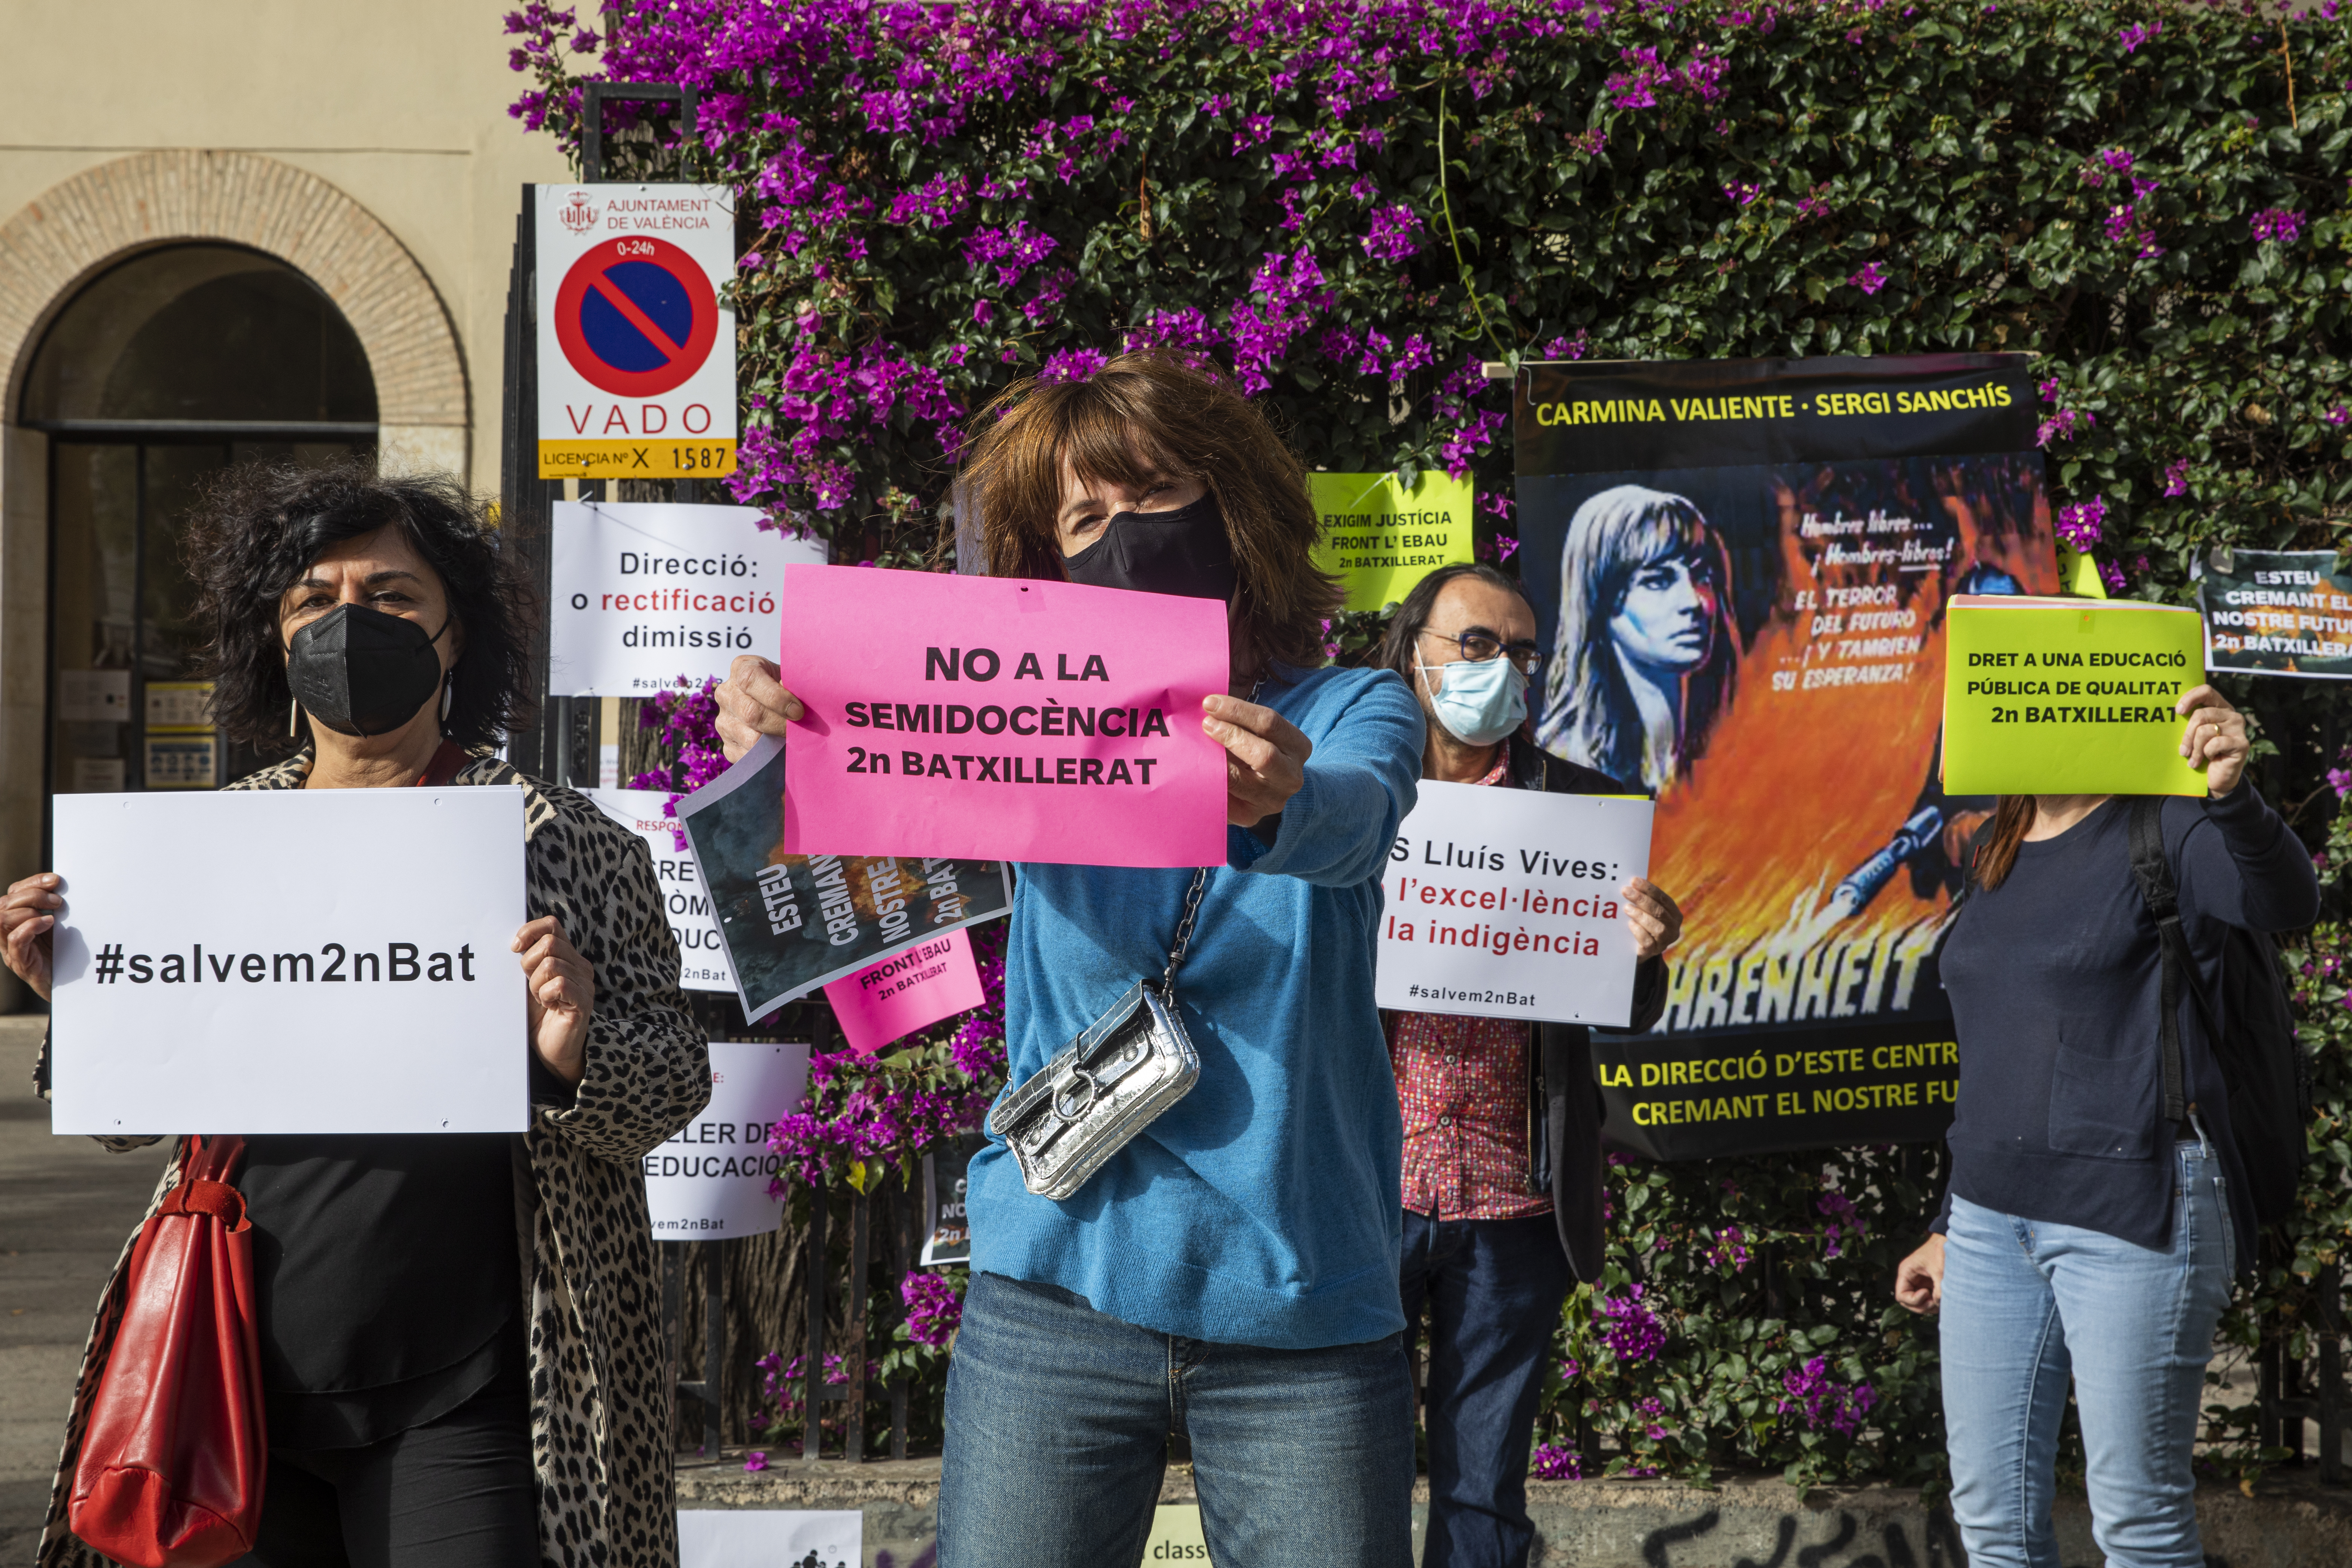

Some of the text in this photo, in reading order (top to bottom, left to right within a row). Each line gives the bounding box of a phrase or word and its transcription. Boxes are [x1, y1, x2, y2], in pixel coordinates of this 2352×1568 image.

[607, 199, 711, 212] AJUNTAMENT
[607, 214, 710, 229] DE VALÈNCIA
[617, 240, 655, 256] 0-24h
[1536, 399, 1665, 426] CARMINA
[1670, 395, 1795, 422] VALIENTE
[1816, 392, 1891, 416] SERGI
[1897, 382, 2011, 413] SANCHÍS
[566, 403, 711, 434] VADO
[544, 452, 610, 465] LICENCIA
[673, 448, 725, 469] 1587
[1324, 509, 1452, 528] EXIGIM JUSTÍCIA
[1332, 536, 1380, 550] FRONT
[1403, 533, 1447, 548] EBAU
[620, 552, 757, 578] Direcció:
[1339, 555, 1444, 568] 2n BATXILLERAT
[2254, 570, 2320, 586] ESTEU
[571, 589, 775, 615] o rectificació
[1795, 585, 1898, 611] EL TERROR
[2225, 590, 2327, 609] CREMANT
[1811, 610, 1916, 636] DEL FUTURO
[2212, 611, 2352, 634] NOSTRE FUTU
[623, 625, 753, 649] dimissió
[2215, 633, 2240, 650] 2n
[925, 646, 1110, 682] NO A LA
[1968, 650, 2186, 667] DRET A UNA EDUCACIÓ
[1771, 671, 1797, 691] SU
[1967, 677, 2182, 697] PÚBLICA DE QUALITAT
[845, 697, 1170, 738] SEMIDOCÈNCIA
[1991, 706, 2176, 723] 2n BATXILLERAT
[846, 746, 1157, 785] 2n BATXILLERAT
[1424, 840, 1505, 871] Lluís
[1520, 849, 1619, 881] Vives:
[756, 863, 802, 935] ESTEU
[807, 854, 859, 946] CREMAN
[866, 856, 911, 943] NOSTRE
[921, 857, 962, 924] 2n BAT
[1388, 915, 1600, 956] la indigència
[95, 942, 476, 985] #salvem2nBat
[680, 968, 726, 981] 2nBat
[860, 953, 915, 990] FRONT
[878, 962, 947, 1001] 2n BATXILLERAT
[1651, 939, 1936, 1034] HRENHEIT
[1409, 984, 1536, 1006] #salvem2nBat
[1599, 1064, 1633, 1087] LA
[1641, 1050, 1768, 1087] DIRECCIÓ
[1871, 1041, 1959, 1069] CENTR
[1632, 1079, 1959, 1125] CREMANT EL NOSTRE FU
[1154, 1540, 1210, 1559] class
